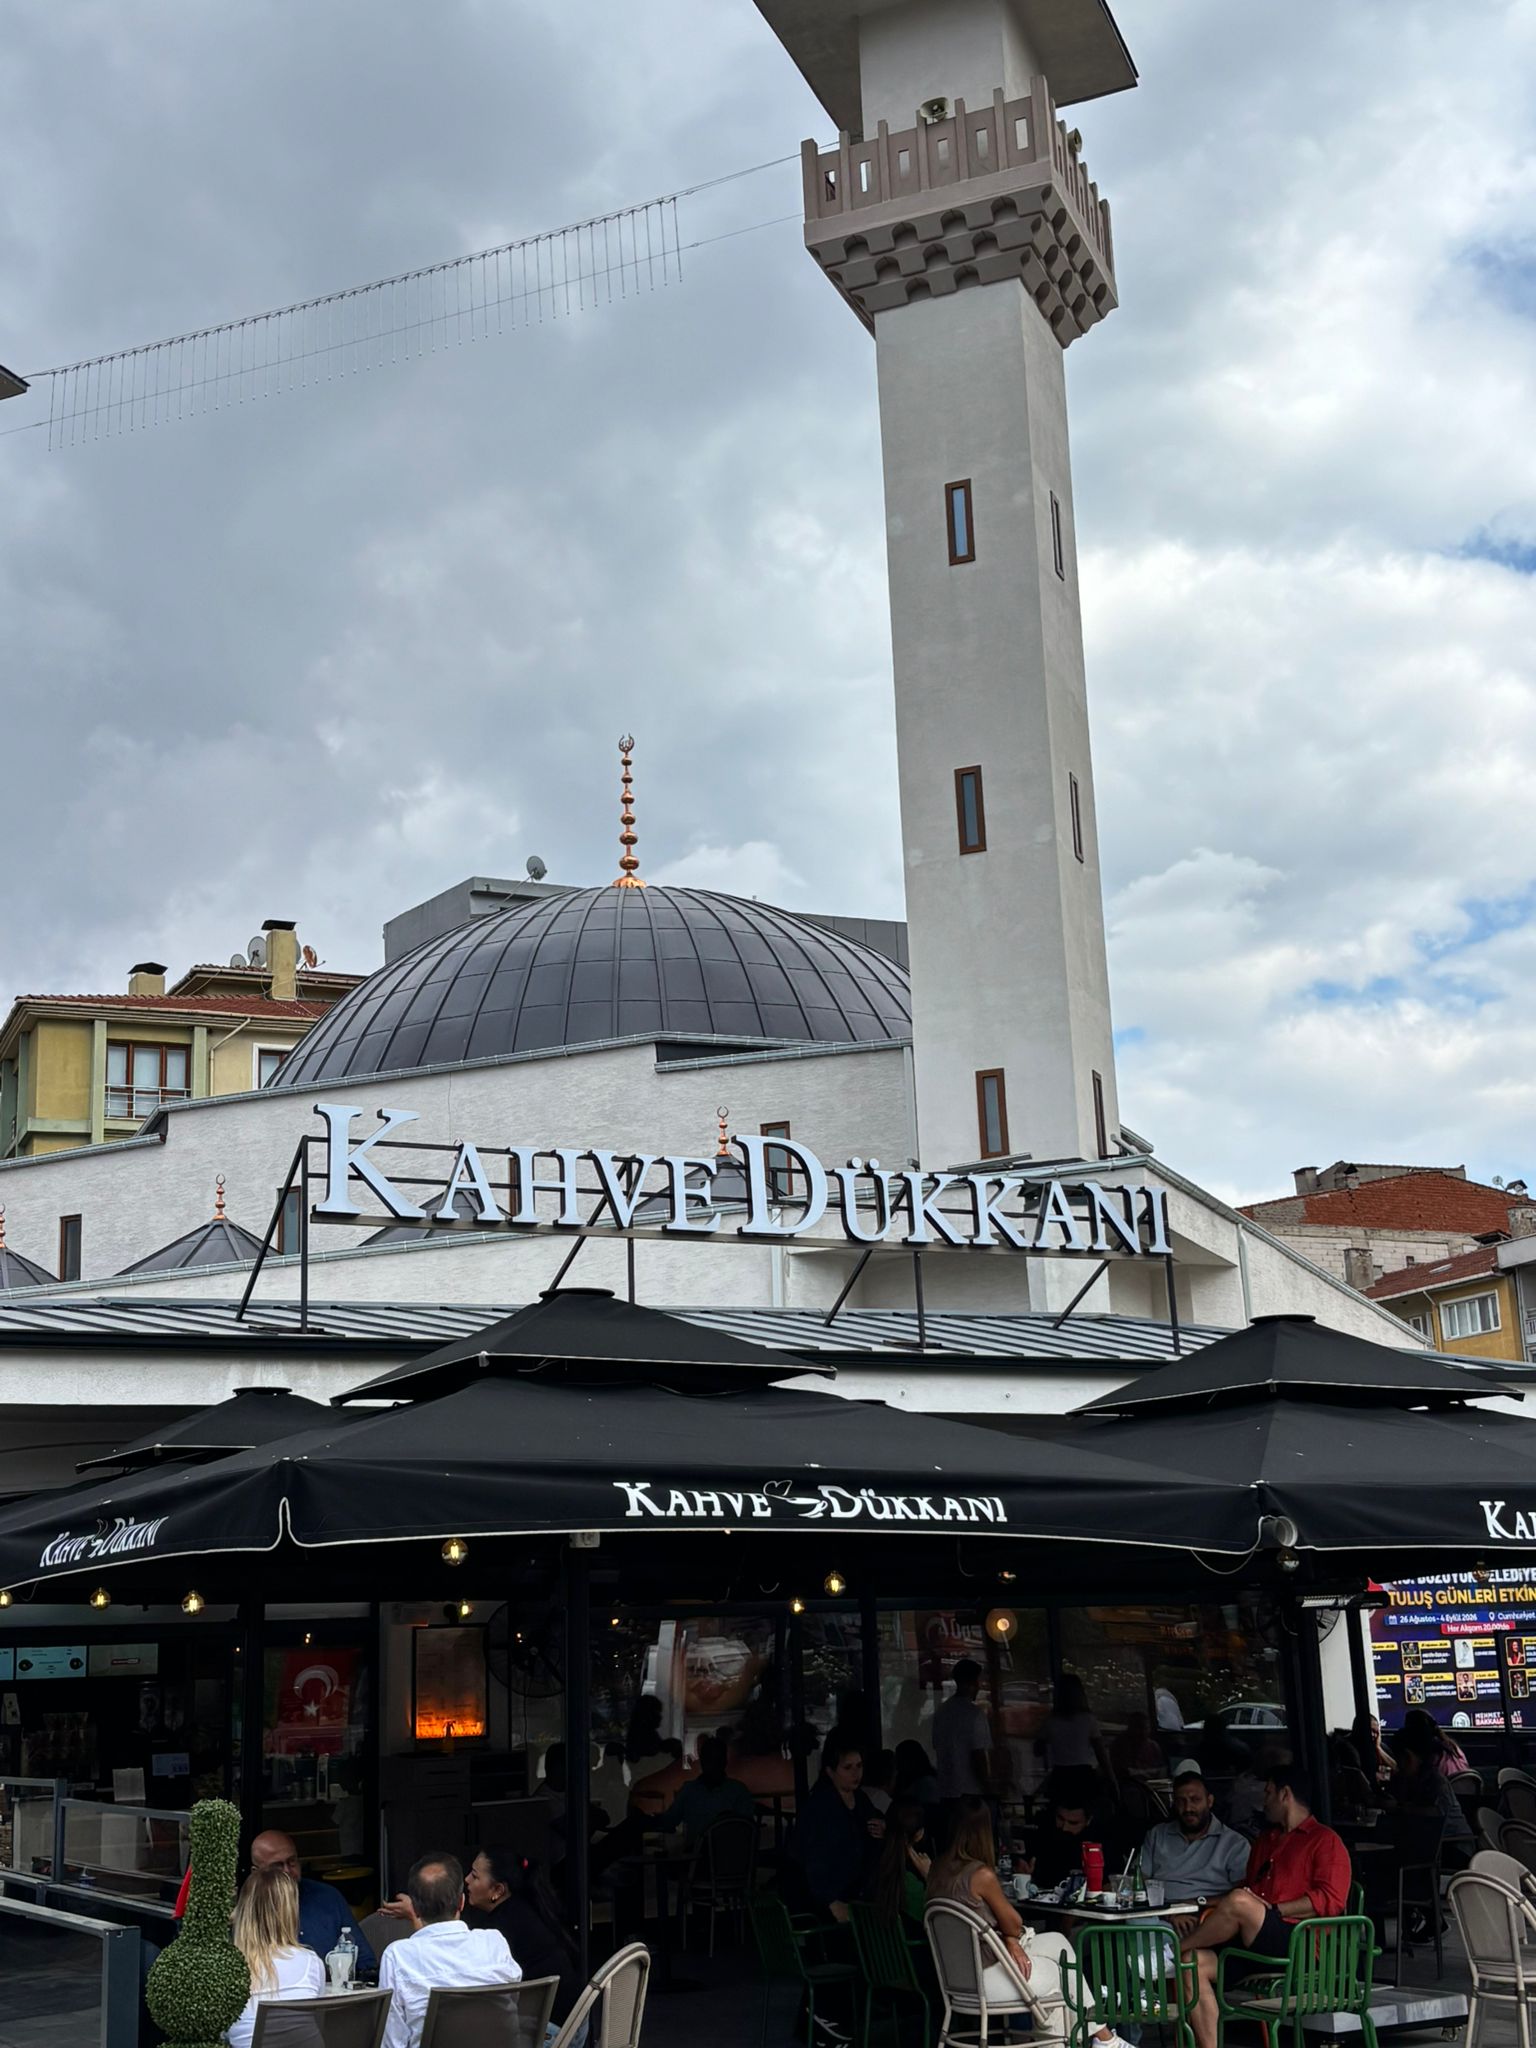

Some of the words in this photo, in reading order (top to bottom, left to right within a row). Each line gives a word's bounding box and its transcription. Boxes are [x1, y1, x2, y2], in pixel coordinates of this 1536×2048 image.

[313, 1103, 722, 1233] KAHVE
[732, 1134, 1174, 1254] DÜKKANI
[613, 1481, 772, 1517] KAHVE
[818, 1485, 1008, 1522] DÜKKANI
[1436, 1585, 1497, 1604] GÜNLERİ
